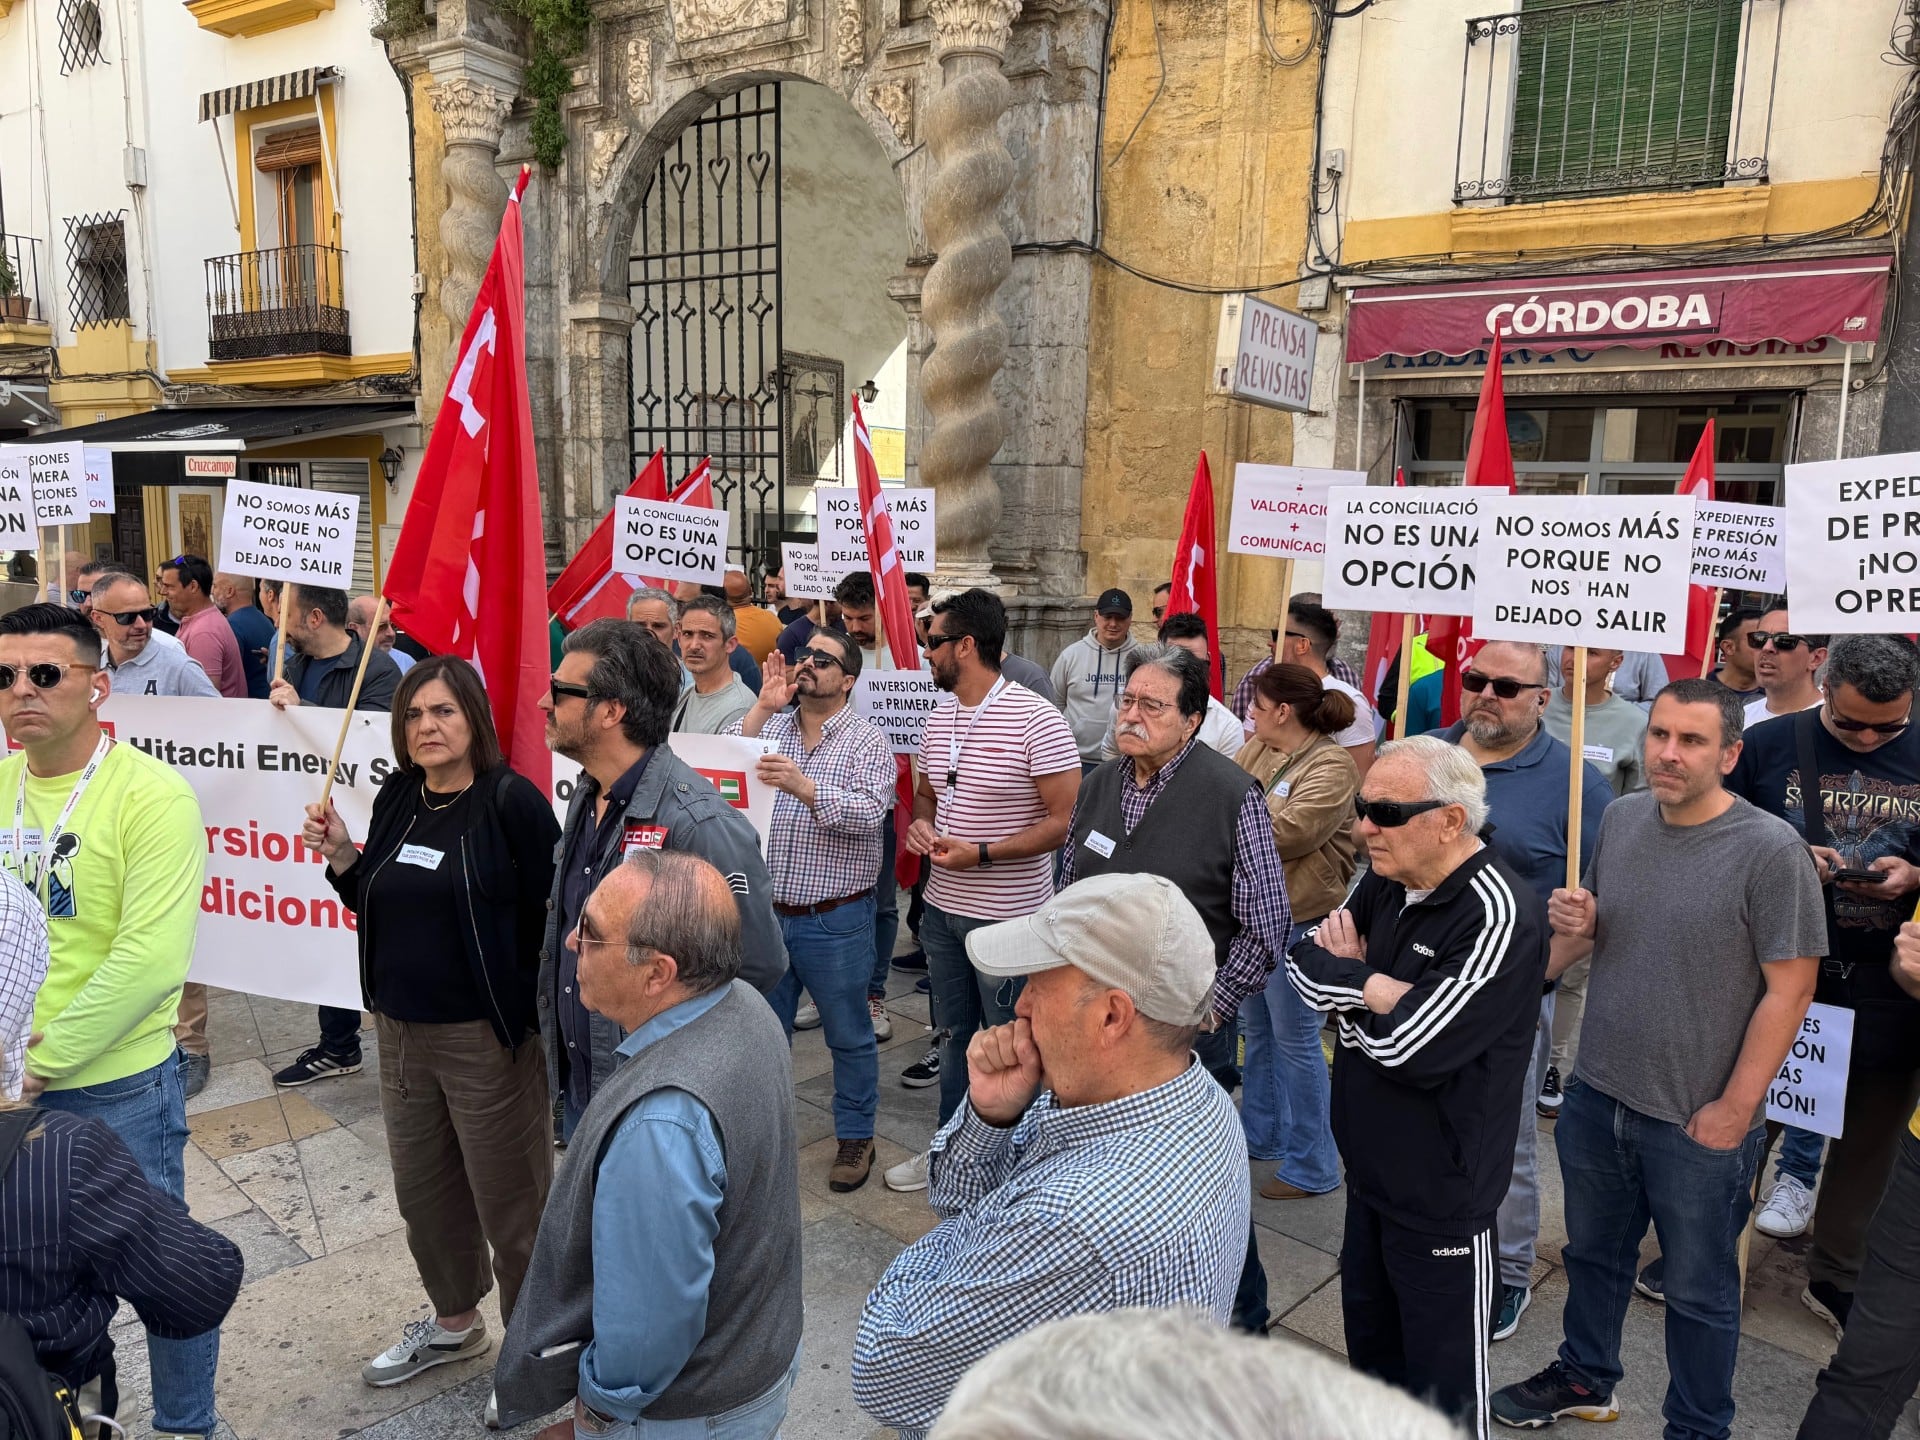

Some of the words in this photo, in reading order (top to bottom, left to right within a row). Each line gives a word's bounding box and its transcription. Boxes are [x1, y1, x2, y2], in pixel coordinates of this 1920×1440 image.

[1486, 296, 1711, 337] CÓRDOBA
[1251, 309, 1306, 359] PRENSA
[1240, 352, 1308, 401] REVISTAS
[188, 458, 235, 474] Cruzcampo
[237, 494, 262, 509] NO
[267, 501, 310, 515] SOMOS
[314, 502, 350, 520] MÁS
[827, 500, 849, 512] NO
[896, 497, 927, 512] MÁS
[1250, 499, 1327, 515] VALORACI
[1347, 501, 1364, 514] LA
[1369, 499, 1478, 515] CONCILIACIÓ
[628, 506, 640, 516] LA
[643, 509, 719, 527] CONCILIACIÓN
[900, 520, 920, 530] NO
[1496, 516, 1534, 536] NO
[1541, 522, 1611, 538] SOMOS
[1618, 511, 1679, 539] MÁS
[243, 515, 309, 535] PORQUE
[318, 526, 340, 539] NO
[627, 521, 653, 536] NO
[660, 526, 676, 540] ES
[683, 529, 718, 546] UNA
[1344, 524, 1384, 545] NO
[1394, 525, 1420, 546] ES
[1828, 514, 1869, 541] DE
[259, 536, 285, 549] NOS
[295, 541, 321, 553] HAN
[1707, 528, 1777, 547] PRESIÓN
[235, 551, 292, 569] DEJADO
[300, 558, 342, 575] SALIR
[626, 543, 716, 571] OPCIÓN
[788, 550, 802, 559] NO
[831, 551, 869, 562] DEJAD
[899, 550, 925, 562] ALIR
[1506, 548, 1610, 571] PORQUE
[1624, 554, 1661, 573] NO
[1724, 548, 1757, 562] MÁS
[794, 563, 818, 573] PORQ
[1859, 551, 1917, 580] ¡NO
[804, 574, 817, 582] NOS
[793, 584, 822, 593] DEJADO
[1531, 579, 1570, 595] NOS
[1588, 581, 1629, 598] HAN
[1496, 605, 1582, 627] DEJADO
[1596, 608, 1666, 633] SALIR
[868, 681, 939, 692] INVERSIONES
[873, 701, 884, 710] DE
[886, 698, 938, 711] PRIMERA
[868, 716, 927, 728] CONDICIO
[889, 733, 922, 746] TERC
[1775, 1061, 1802, 1084] ÁS
[1432, 1247, 1470, 1256] adidas
